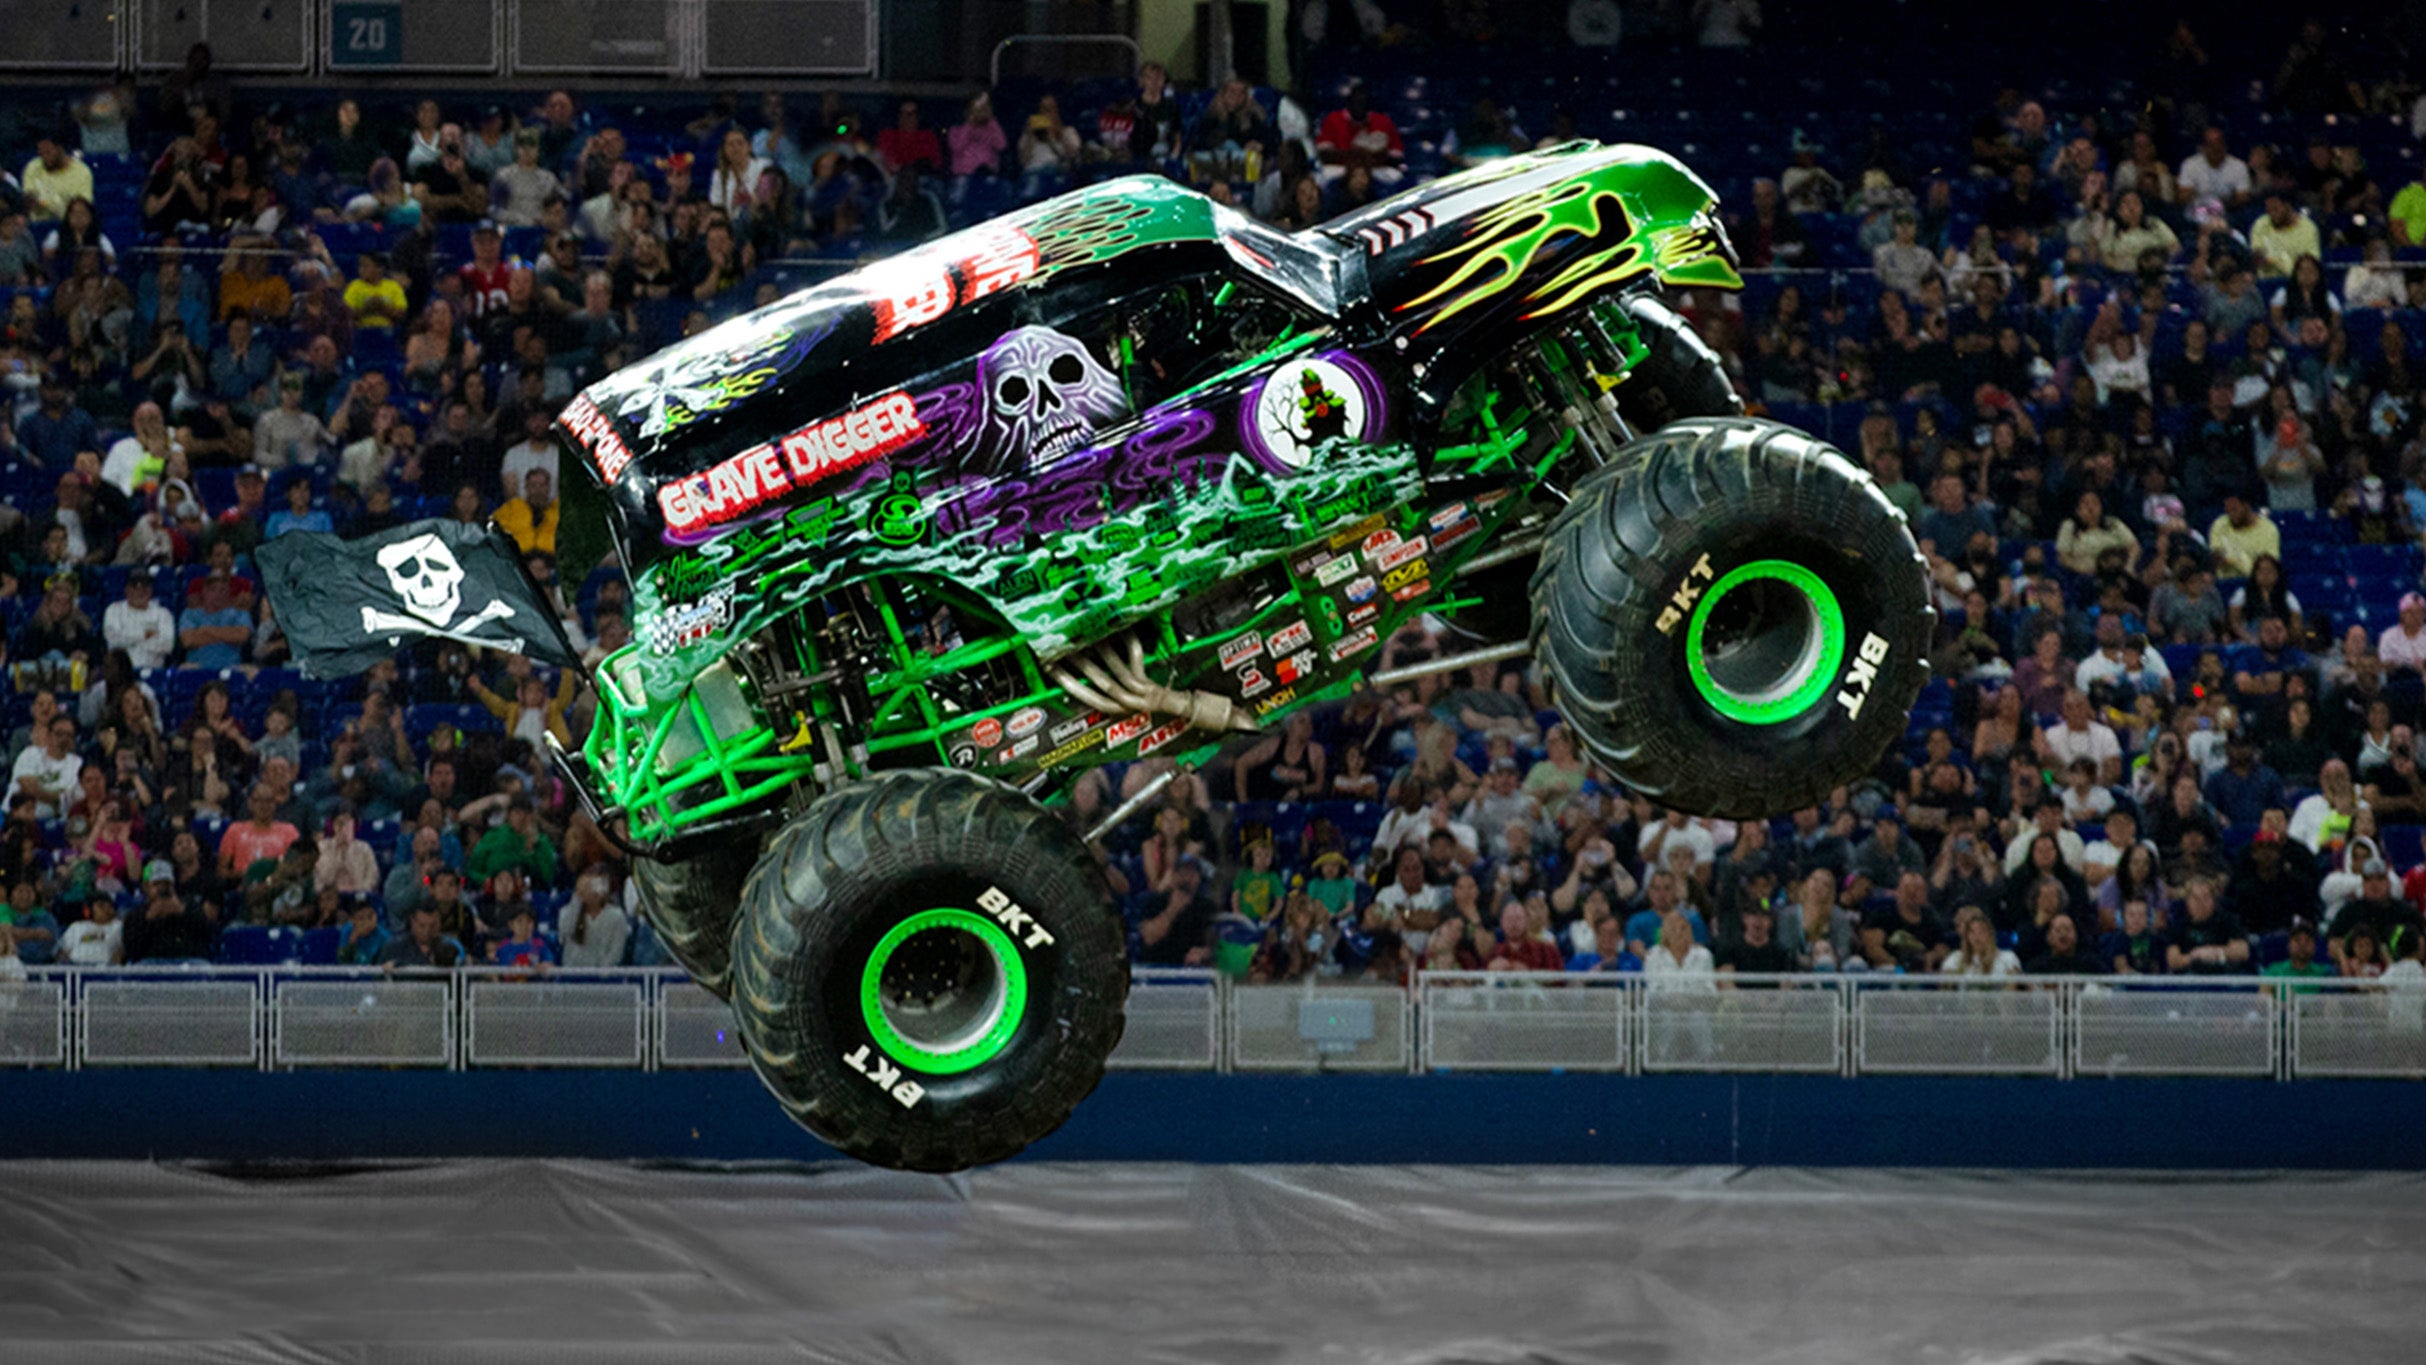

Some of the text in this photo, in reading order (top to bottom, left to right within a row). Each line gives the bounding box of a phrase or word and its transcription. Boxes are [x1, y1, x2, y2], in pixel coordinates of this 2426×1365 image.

[349, 18, 386, 49] 20
[659, 445, 788, 528] GRAVE
[781, 394, 921, 477] DIGGER
[1655, 552, 1714, 634] BKT
[1255, 686, 1296, 715] UNOH
[1837, 632, 1889, 720] BKT
[976, 886, 1055, 949] BKT
[843, 1045, 925, 1109] BKT
